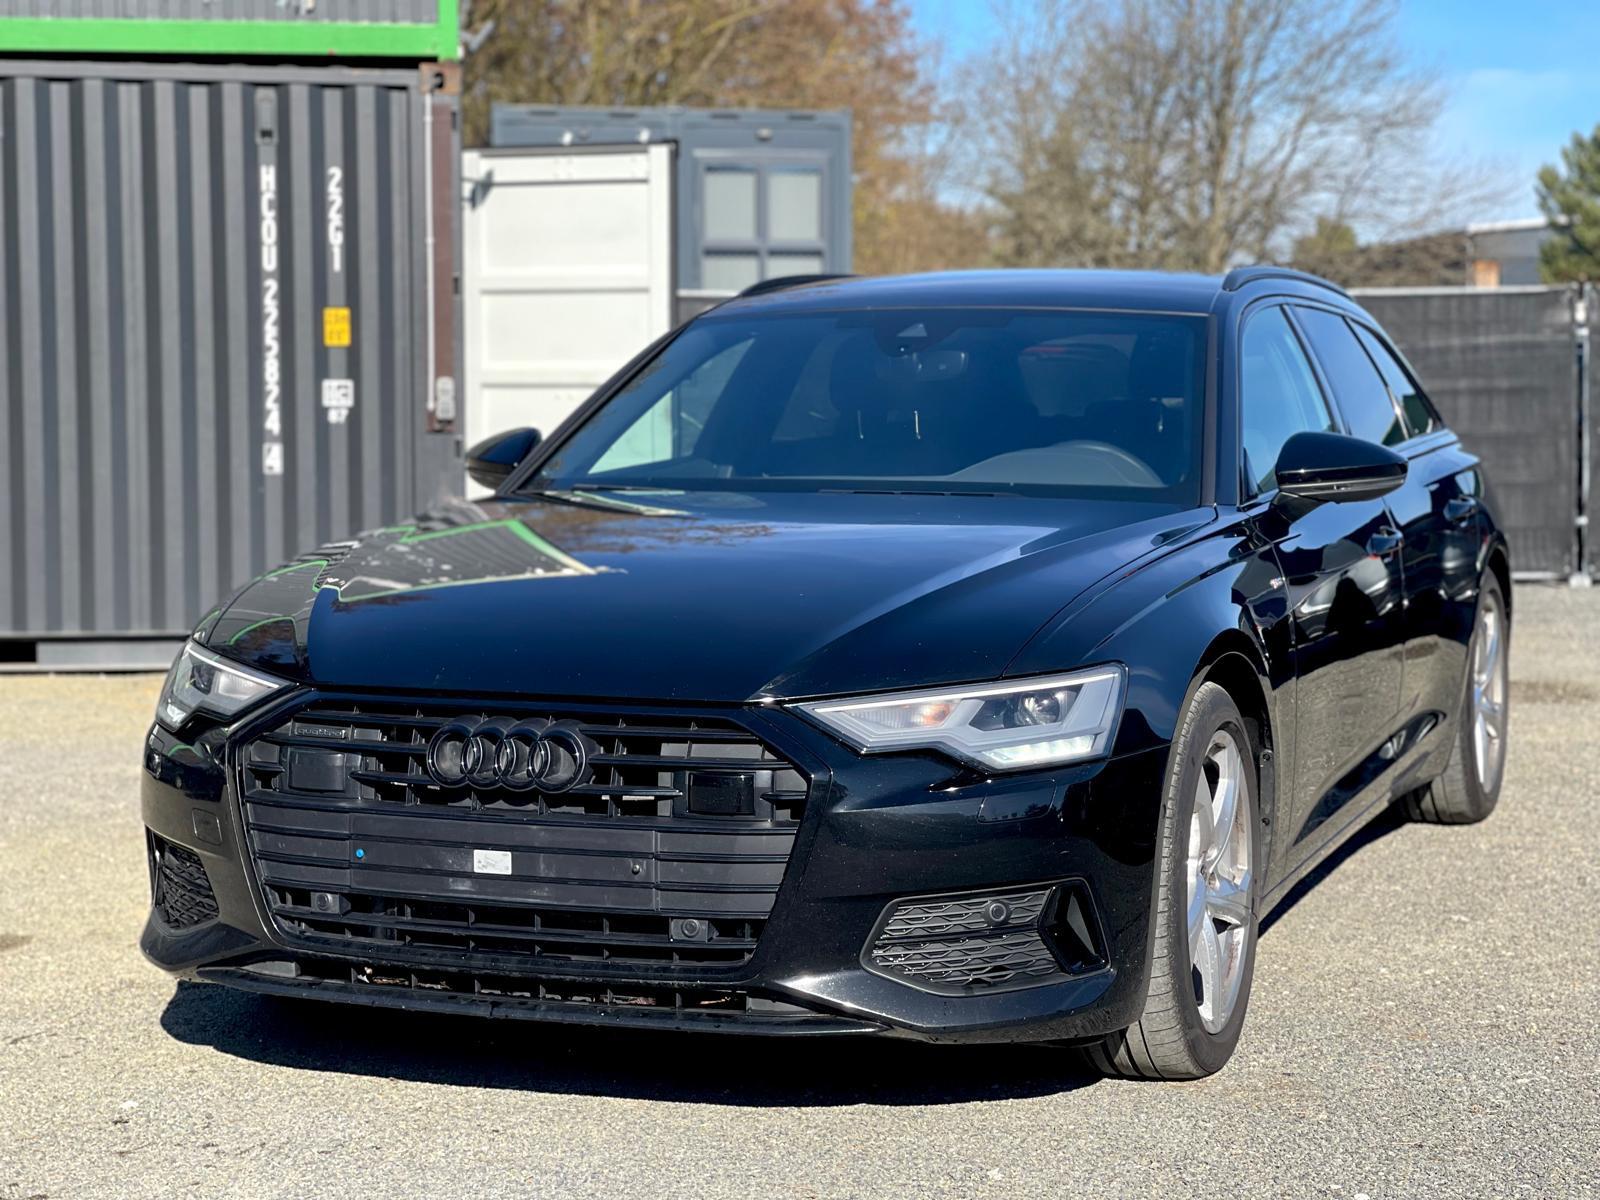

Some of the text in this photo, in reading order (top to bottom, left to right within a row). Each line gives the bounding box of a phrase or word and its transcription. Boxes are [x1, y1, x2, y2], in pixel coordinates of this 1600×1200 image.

[327, 165, 344, 272] 22G1
[260, 164, 283, 474] HCOU 225824 4
[298, 727, 343, 736] quattro
